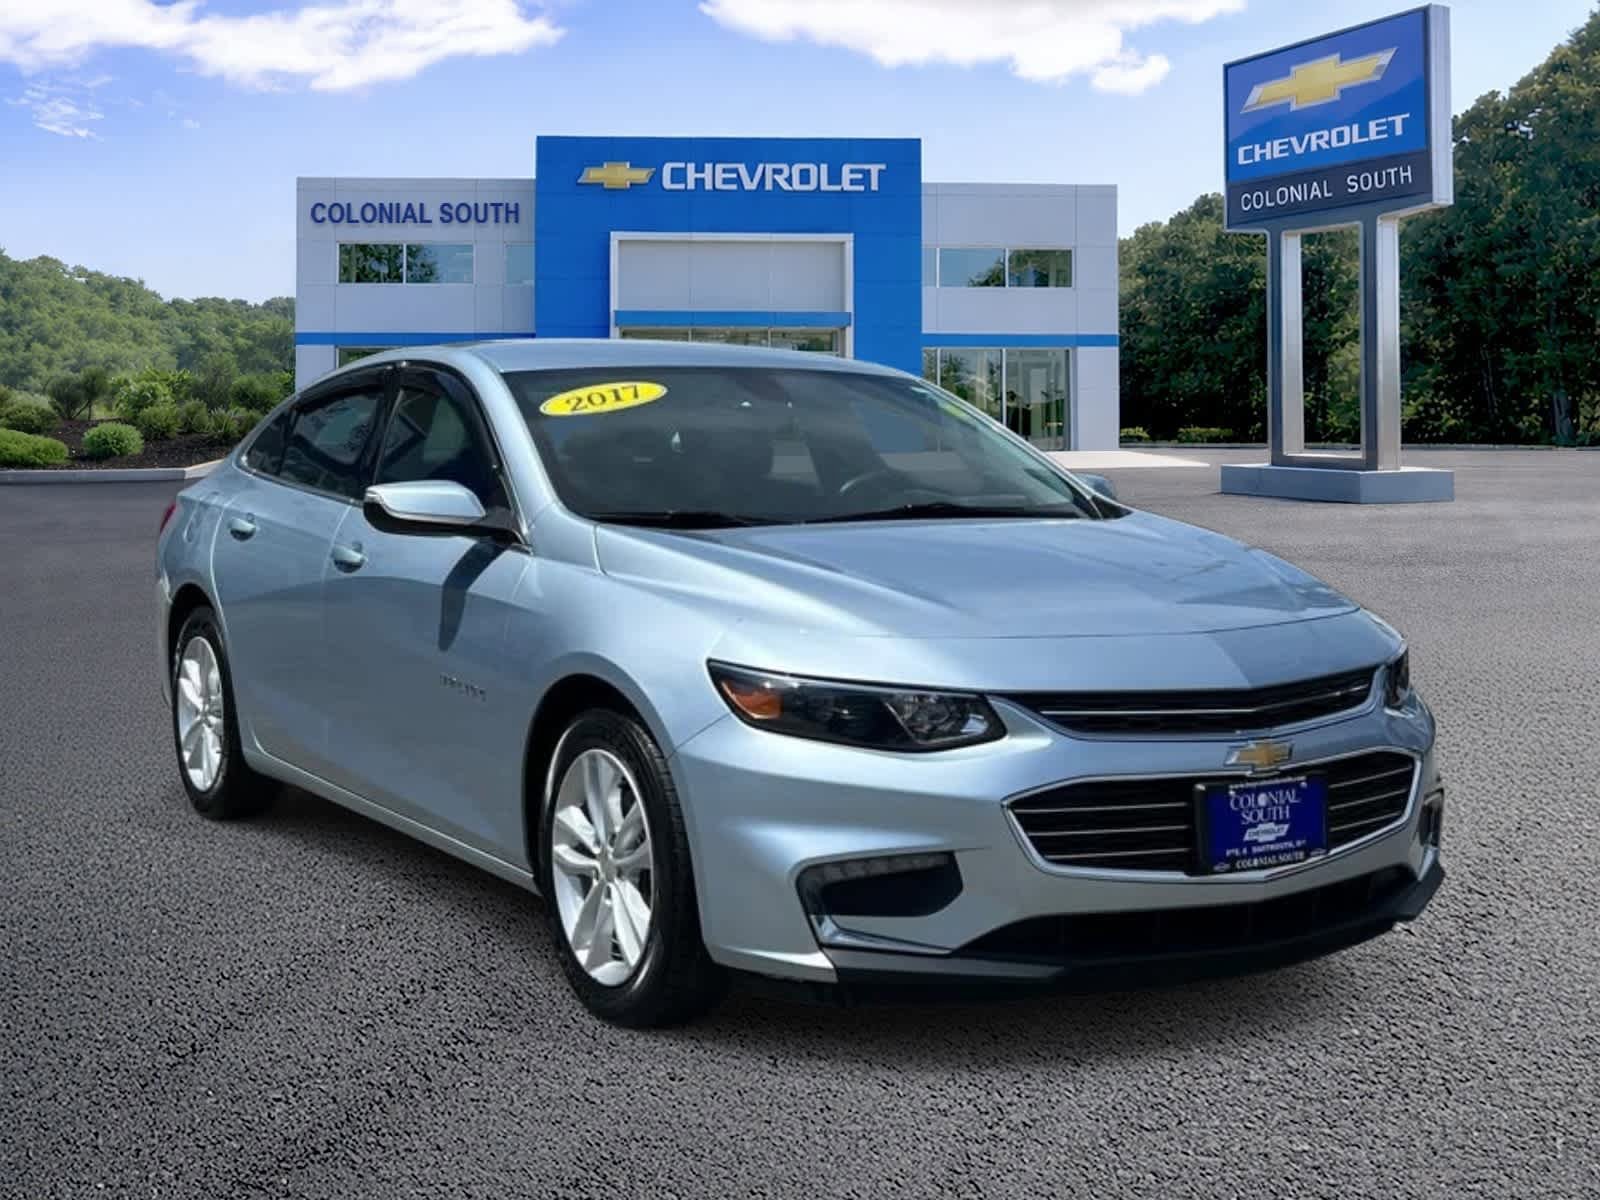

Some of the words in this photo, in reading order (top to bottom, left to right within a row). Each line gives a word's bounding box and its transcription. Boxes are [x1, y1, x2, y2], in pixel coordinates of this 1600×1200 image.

[1237, 112, 1410, 166] CHEVROLET
[661, 161, 887, 192] CHEVROLET
[1240, 179, 1333, 211] COLONIAL
[1346, 165, 1412, 193] SOUTH
[310, 202, 433, 224] COLONIAL
[439, 202, 520, 224] SOUTH
[565, 384, 639, 412] 2017
[1229, 788, 1301, 811] COLONIAL
[1241, 804, 1290, 826] SOUTH
